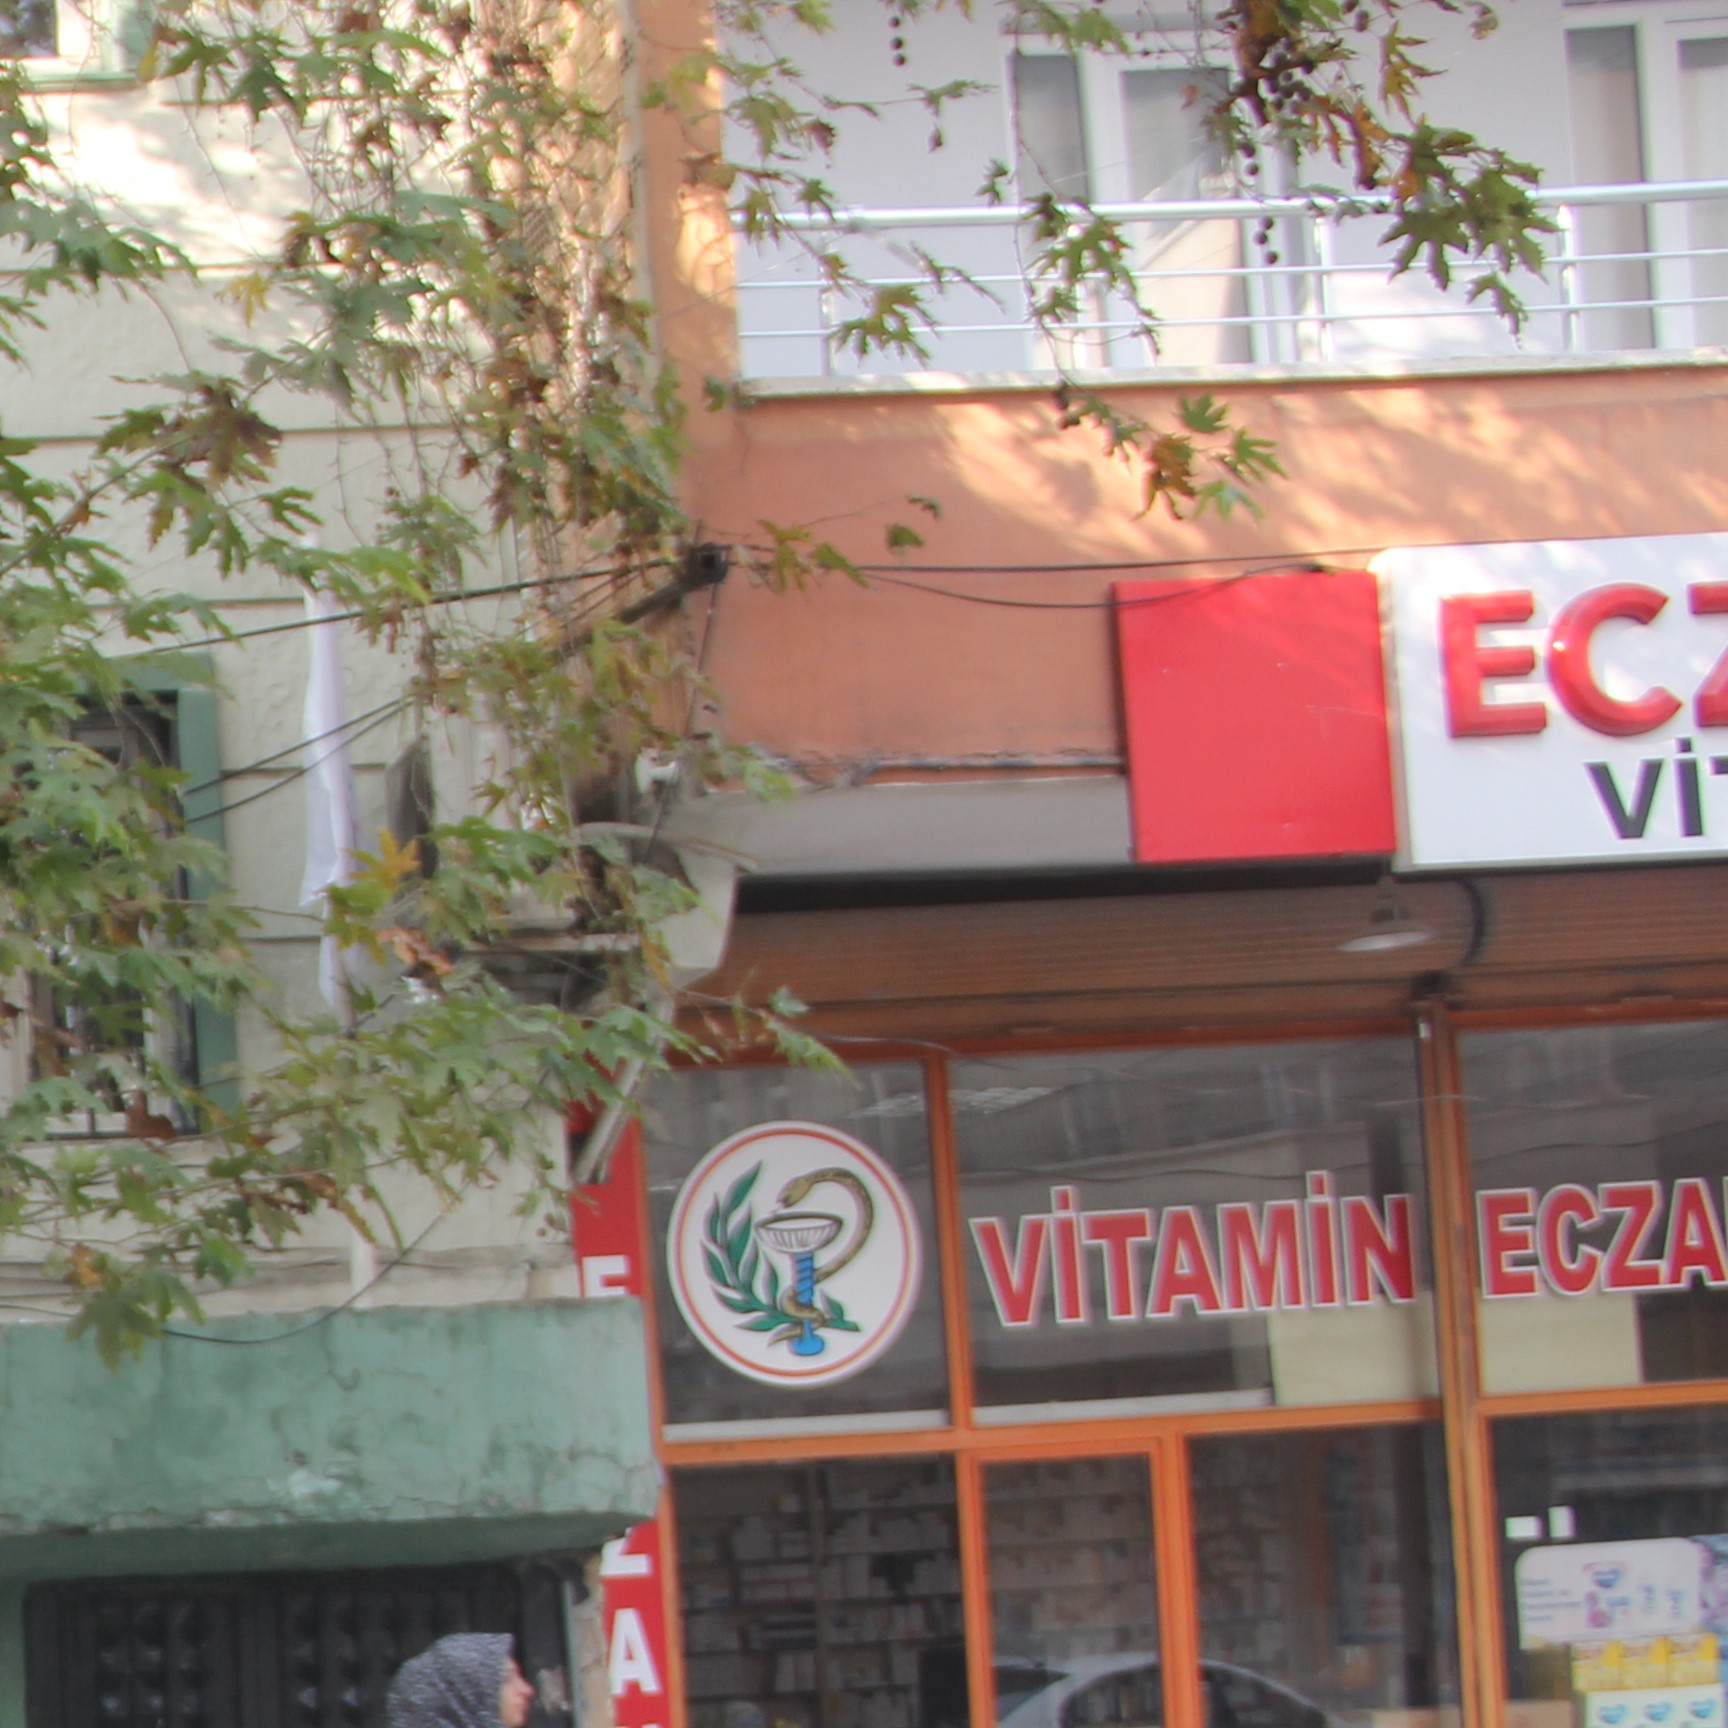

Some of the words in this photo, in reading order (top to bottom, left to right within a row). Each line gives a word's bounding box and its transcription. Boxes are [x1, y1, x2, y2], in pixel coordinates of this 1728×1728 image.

[1583, 737, 1728, 840] Vİ
[969, 1170, 1416, 1328] VİTAMİN
[1475, 1177, 1728, 1300] ECZA
